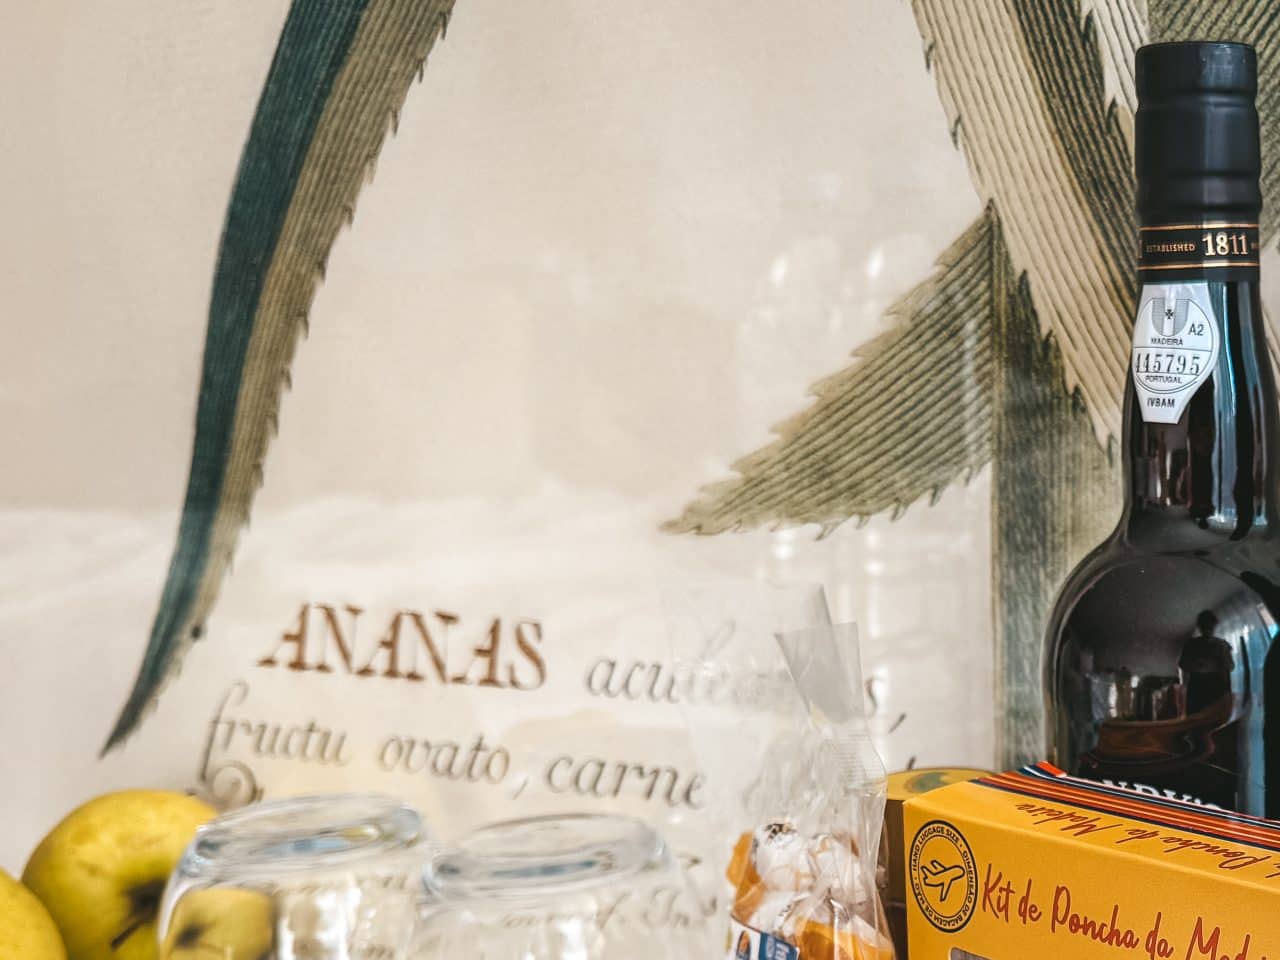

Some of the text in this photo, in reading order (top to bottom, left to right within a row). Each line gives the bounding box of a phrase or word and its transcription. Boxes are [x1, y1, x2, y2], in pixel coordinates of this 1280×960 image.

[1146, 243, 1196, 253] ESTABLISHED
[1202, 231, 1248, 256] 1811
[1150, 337, 1183, 346] MADEIRA
[1188, 323, 1204, 336] A2
[1145, 375, 1182, 384] PORTUGAL
[1147, 397, 1176, 409] IVBAM
[256, 602, 548, 692] ANANAS
[198, 679, 706, 810] fructu ovato, carne
[1016, 802, 1122, 837] Madeira
[912, 826, 960, 871] HAND LUGGAGE SIZE
[1160, 834, 1271, 871] Poncha
[982, 863, 1015, 923] Kit
[1018, 878, 1042, 925] de
[1051, 885, 1139, 950] Poncha
[1145, 911, 1174, 960] da
